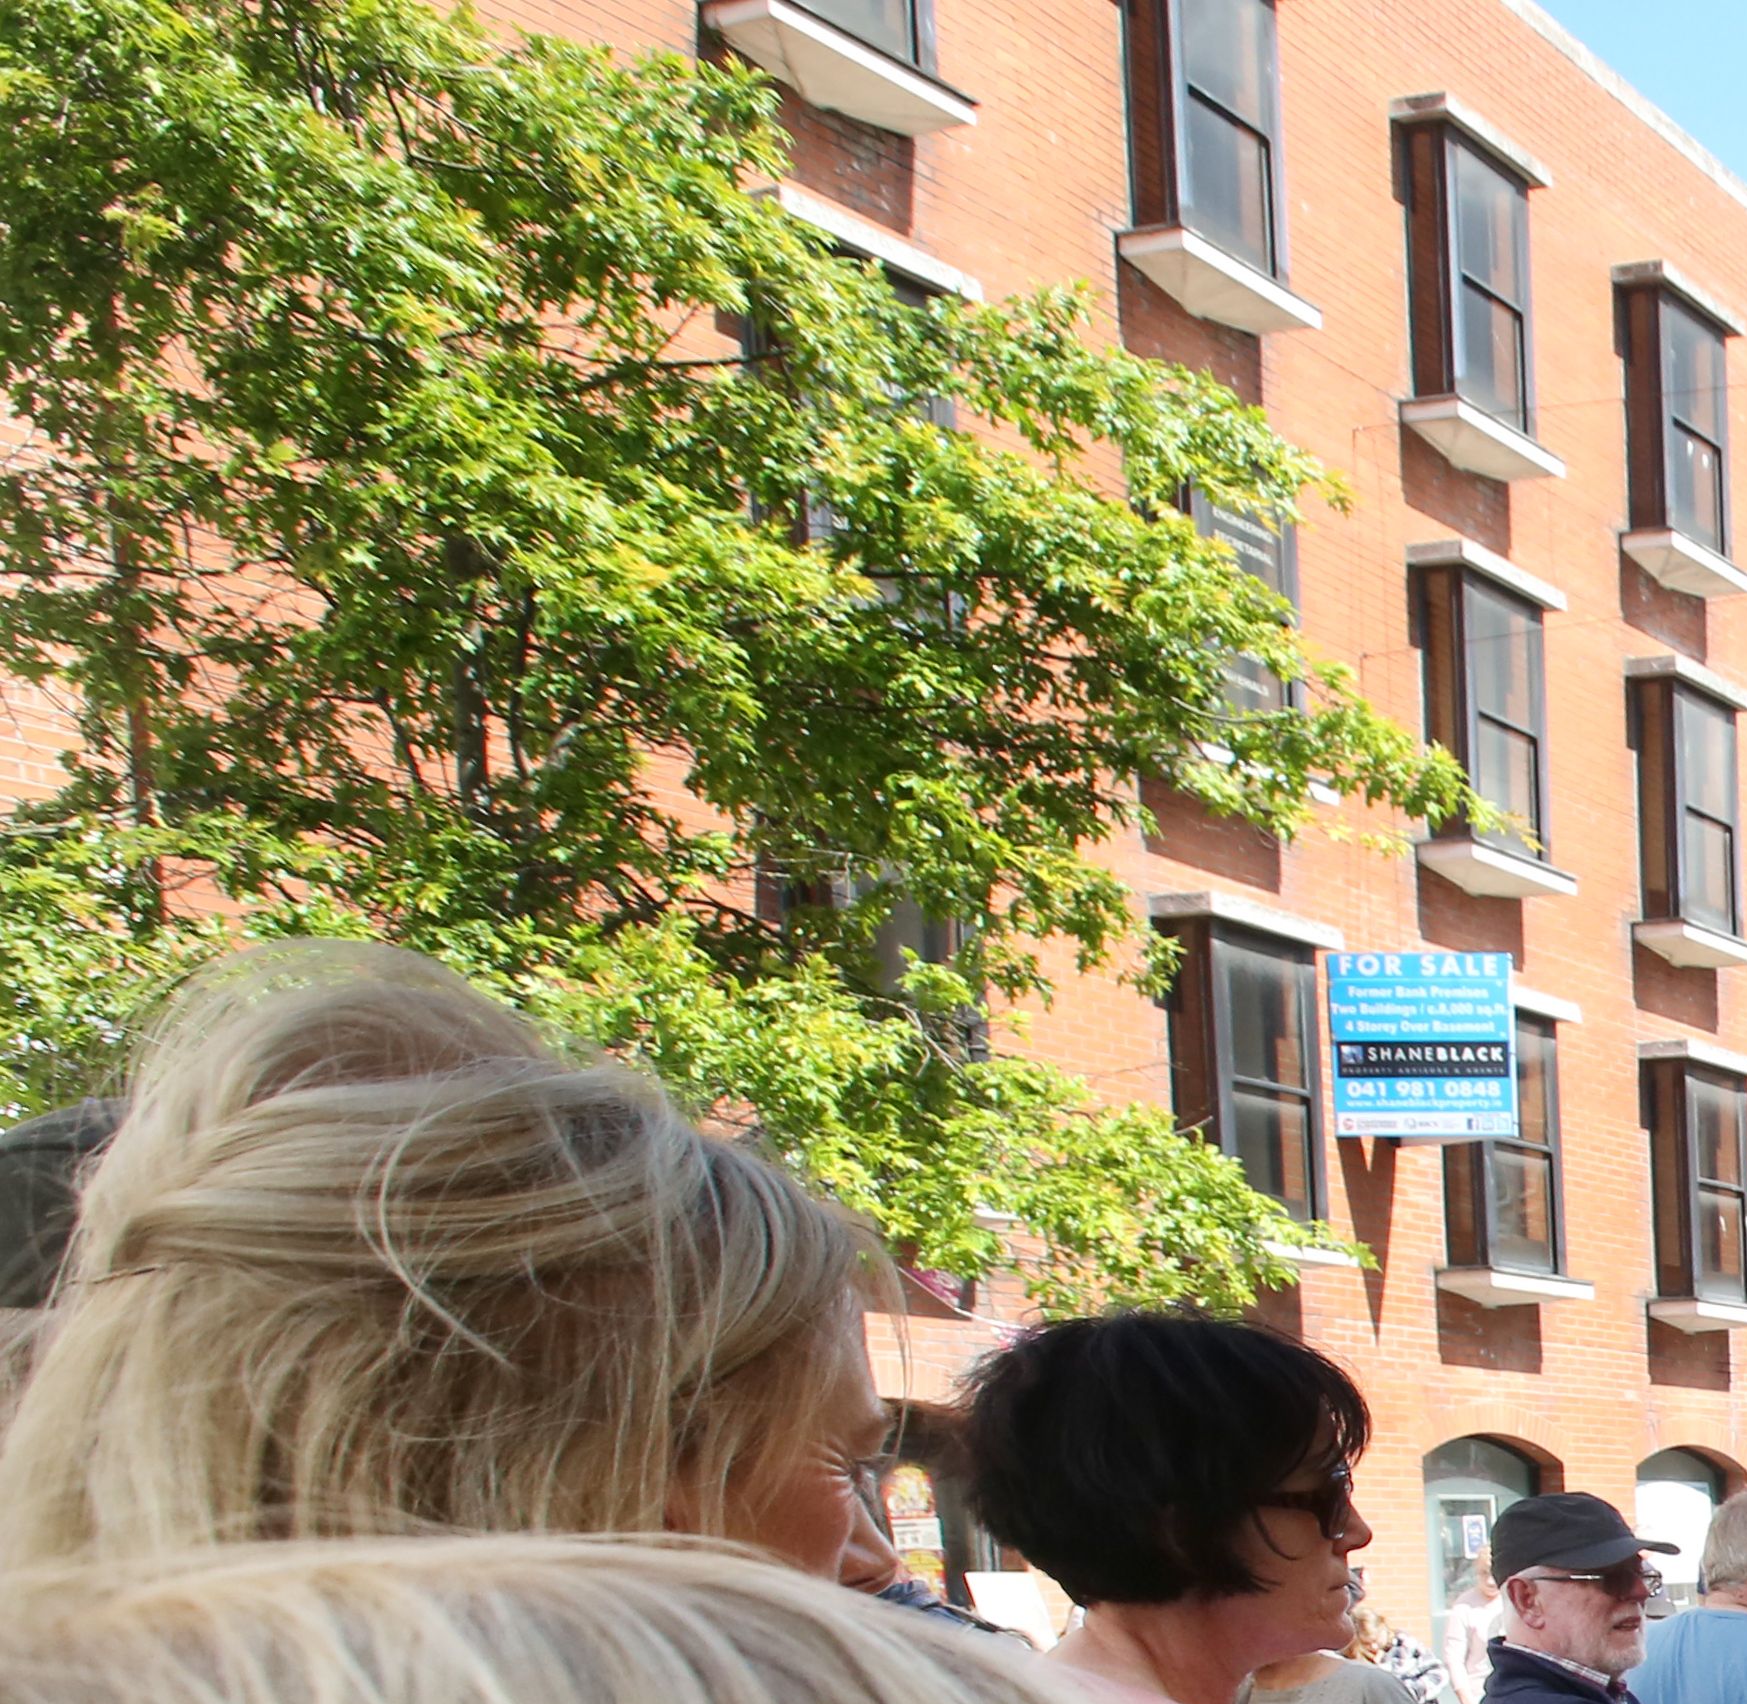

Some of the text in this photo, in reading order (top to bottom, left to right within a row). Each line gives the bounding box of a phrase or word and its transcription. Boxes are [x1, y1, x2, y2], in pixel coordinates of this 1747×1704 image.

[1338, 955, 1499, 977] FOR SALE
[1395, 985, 1428, 998] Bank
[1331, 1002, 1357, 1015] Two
[1358, 1003, 1418, 1017] Buildings
[1345, 1021, 1496, 1035] 4 Storey Over Basement
[1367, 1046, 1505, 1062] SHANEBLACK
[1347, 1081, 1501, 1098] 041 981 0848
